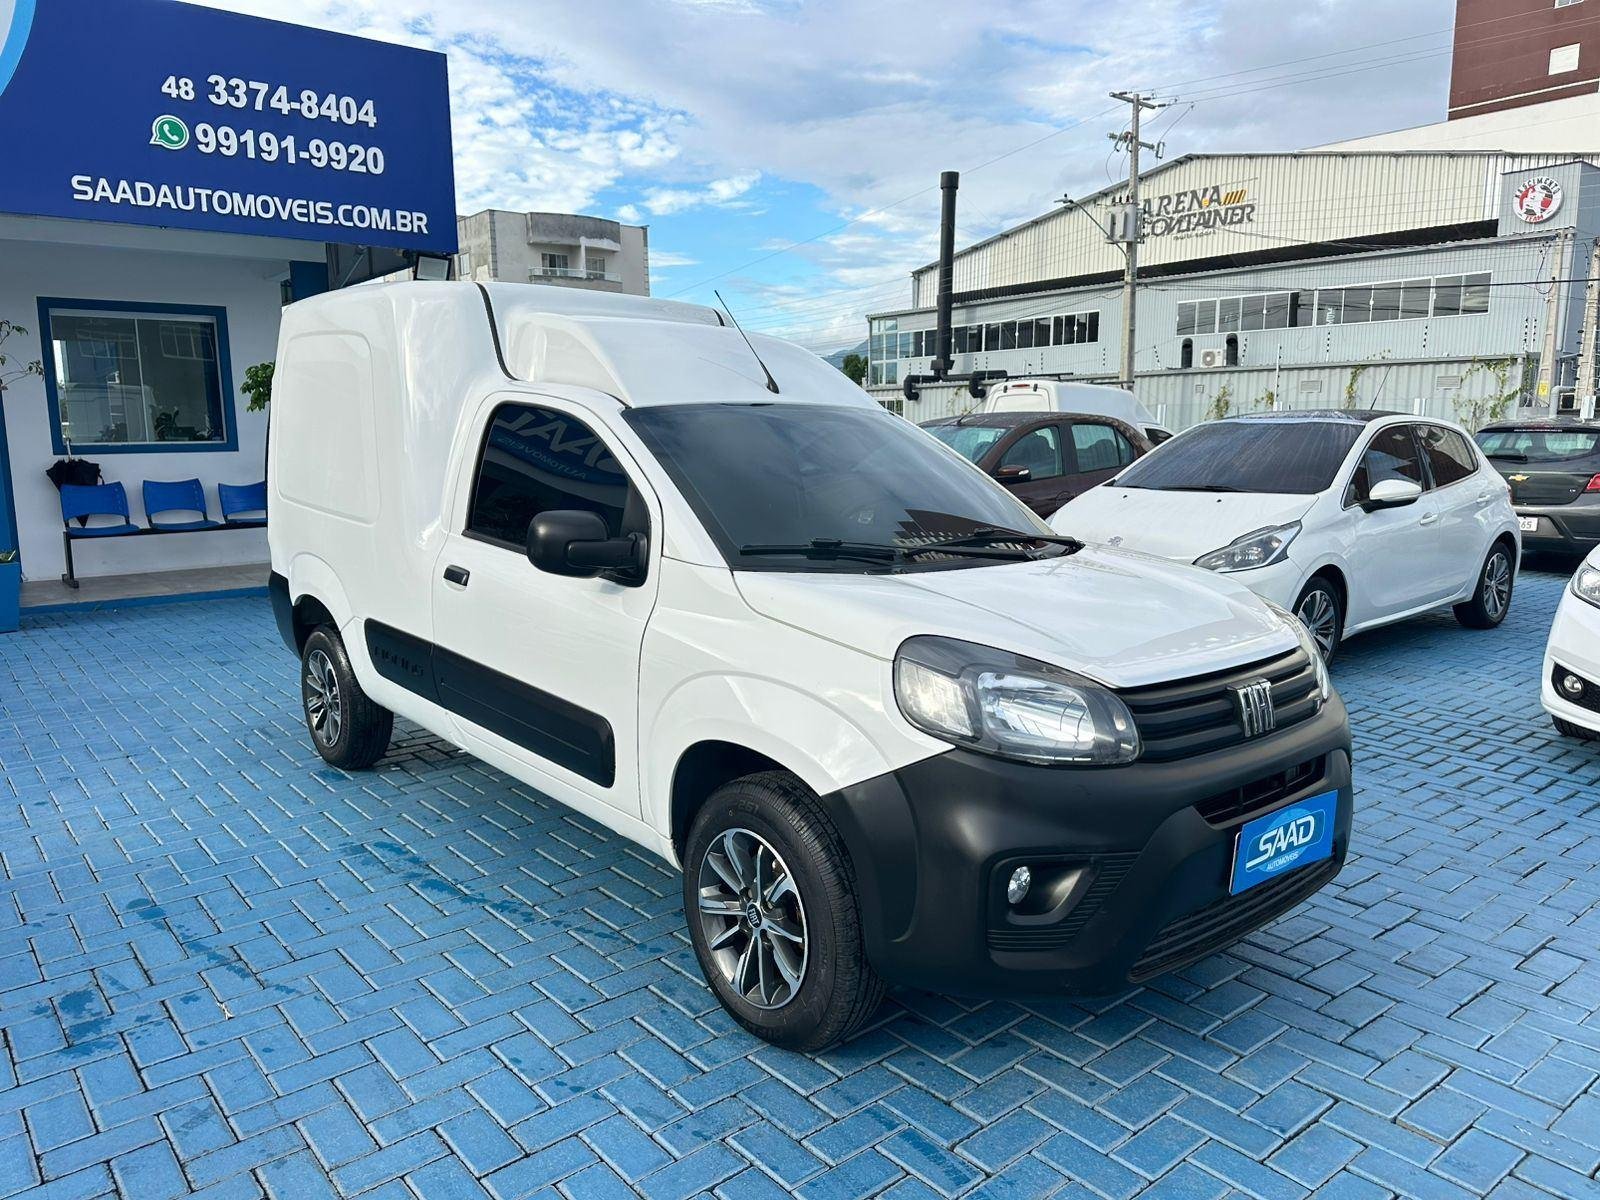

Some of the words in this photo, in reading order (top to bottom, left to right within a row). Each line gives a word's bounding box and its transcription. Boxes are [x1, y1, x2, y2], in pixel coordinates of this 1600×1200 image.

[161, 75, 195, 101] 48
[207, 74, 377, 128] 3374-8404
[195, 123, 385, 175] 99191-9920
[71, 174, 429, 234] SAADAUTOMOVEIS.COM.BR
[1143, 185, 1222, 217] ARENA
[1236, 682, 1276, 737] FIAT
[1246, 815, 1315, 868] SAAD
[748, 907, 760, 925] FIAT
